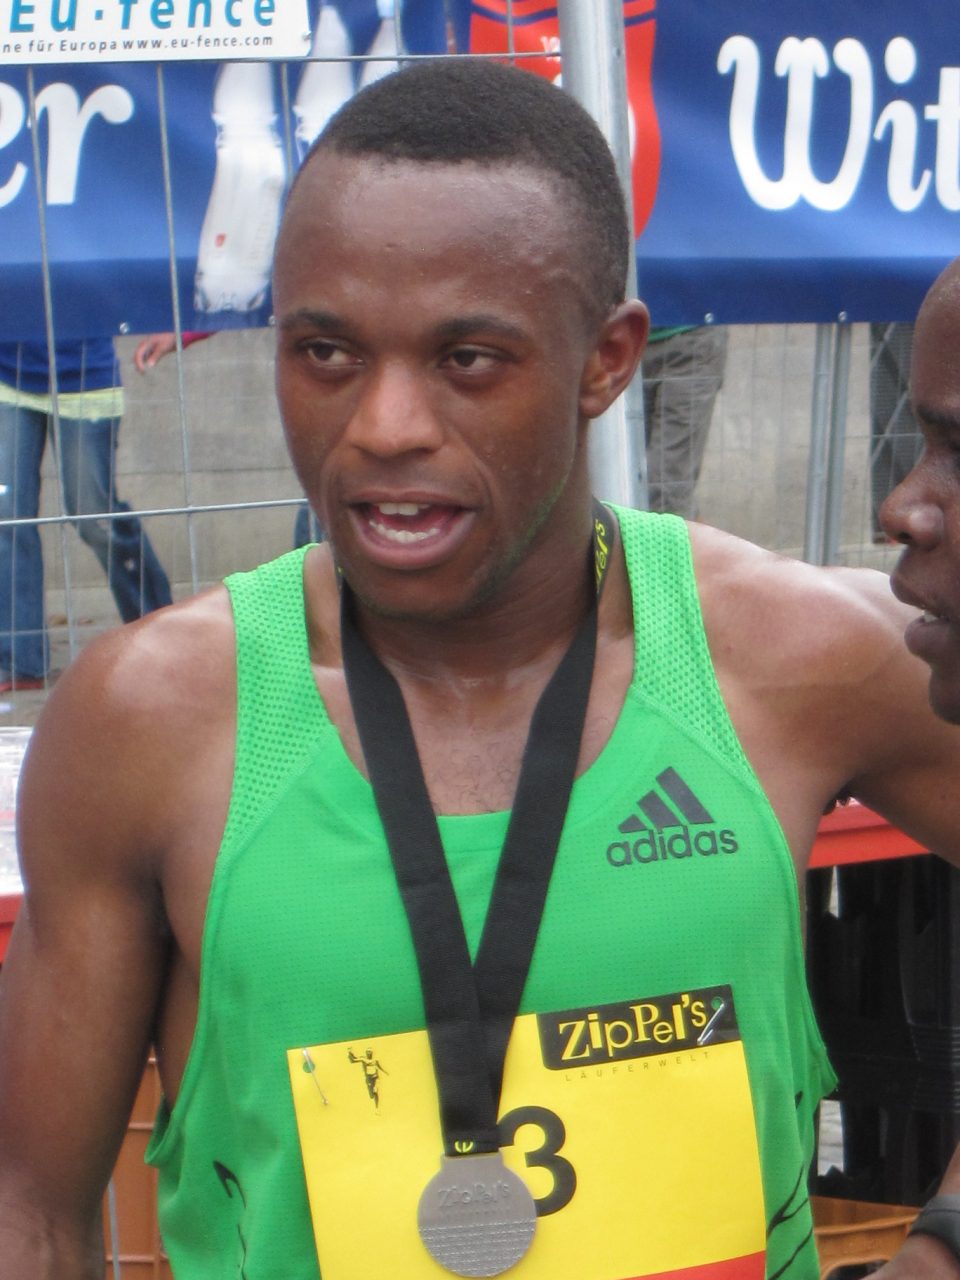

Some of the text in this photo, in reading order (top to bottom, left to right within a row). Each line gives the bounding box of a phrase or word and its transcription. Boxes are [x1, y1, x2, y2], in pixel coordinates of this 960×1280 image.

[28, 40, 54, 53] für
[59, 39, 118, 54] Europa
[122, 34, 274, 50] www.eu-fence.com
[606, 824, 740, 868] adidas
[558, 993, 708, 1061] ZipPel's
[497, 1105, 577, 1218] 3
